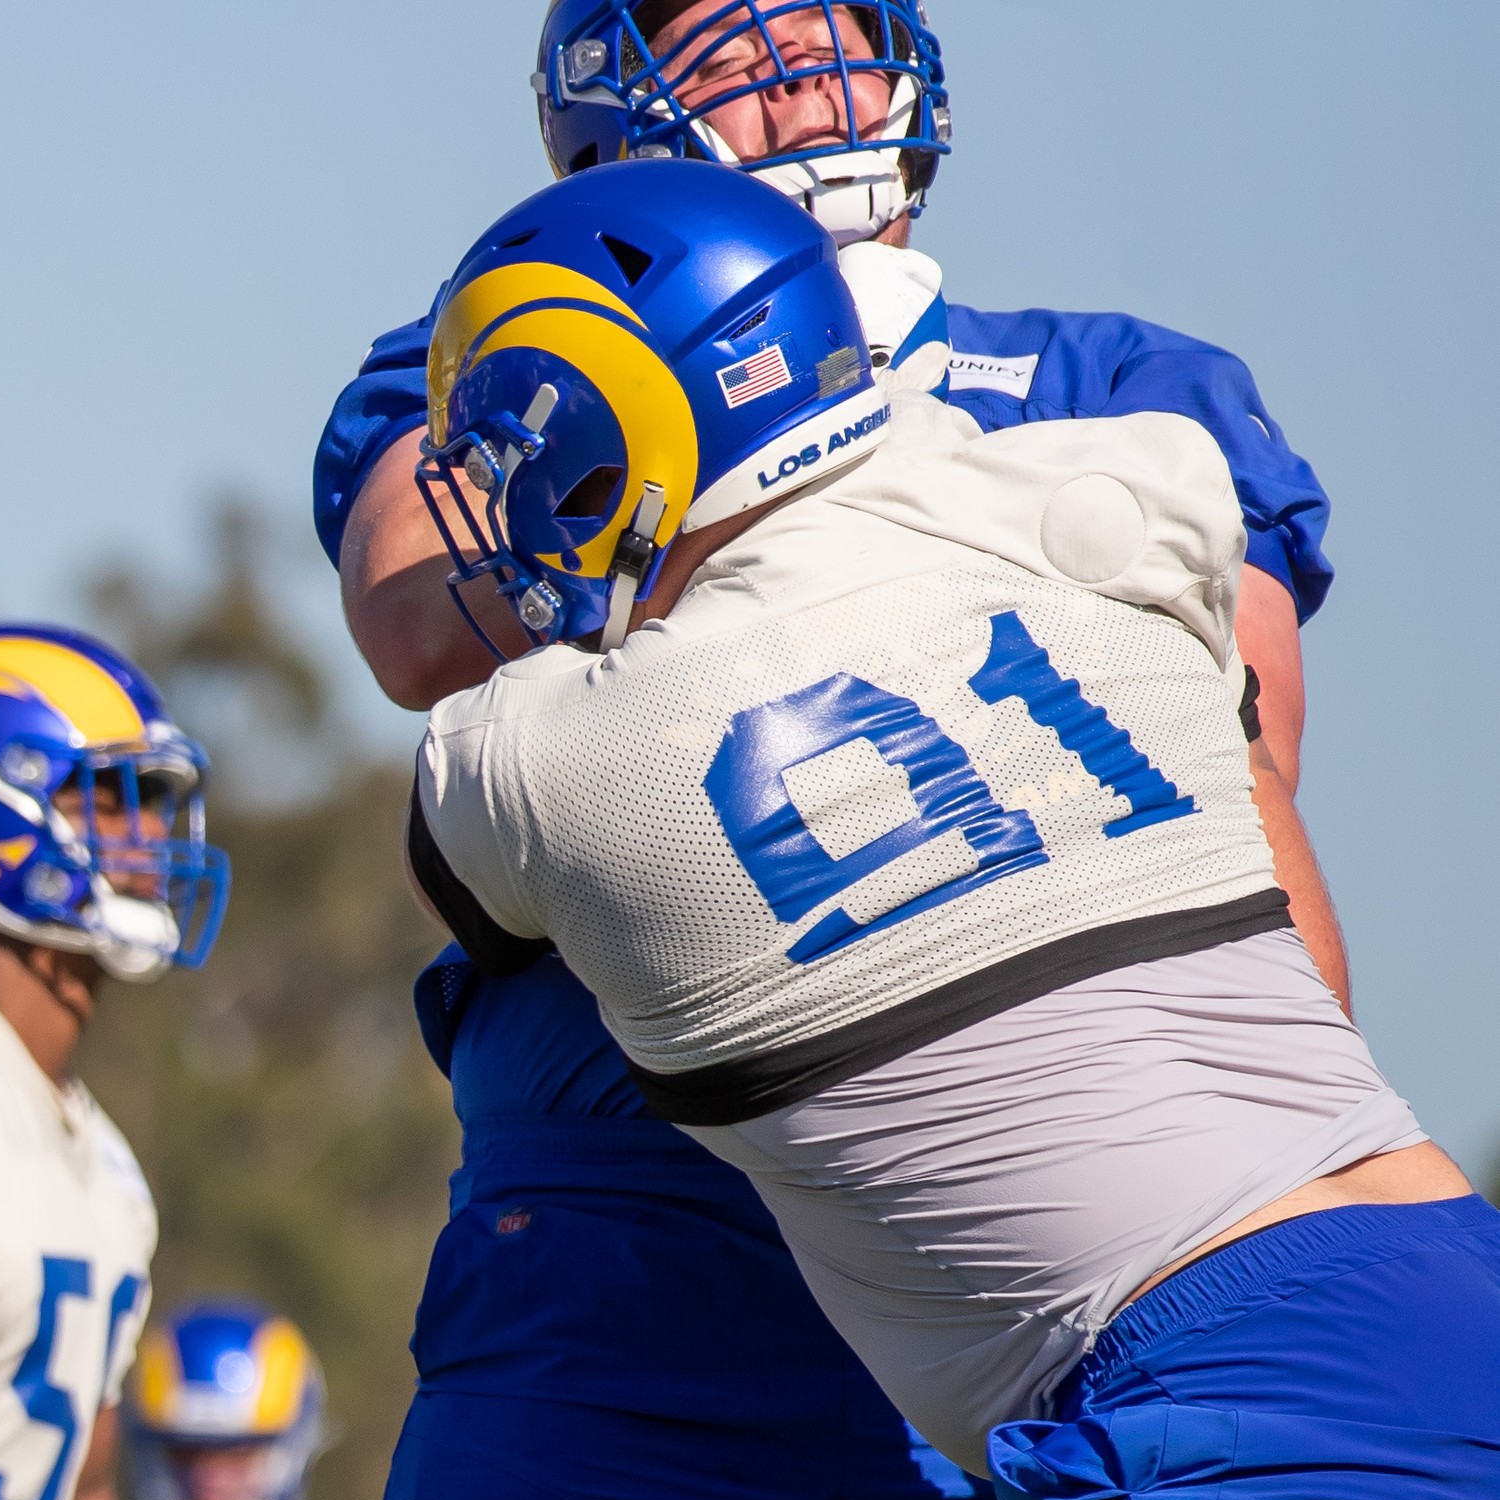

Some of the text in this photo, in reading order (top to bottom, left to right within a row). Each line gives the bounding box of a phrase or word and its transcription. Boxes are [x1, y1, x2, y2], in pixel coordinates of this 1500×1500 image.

[948, 358, 1027, 378] UNIFY
[757, 402, 891, 491] LOS ANGELE
[703, 611, 1201, 964] 91
